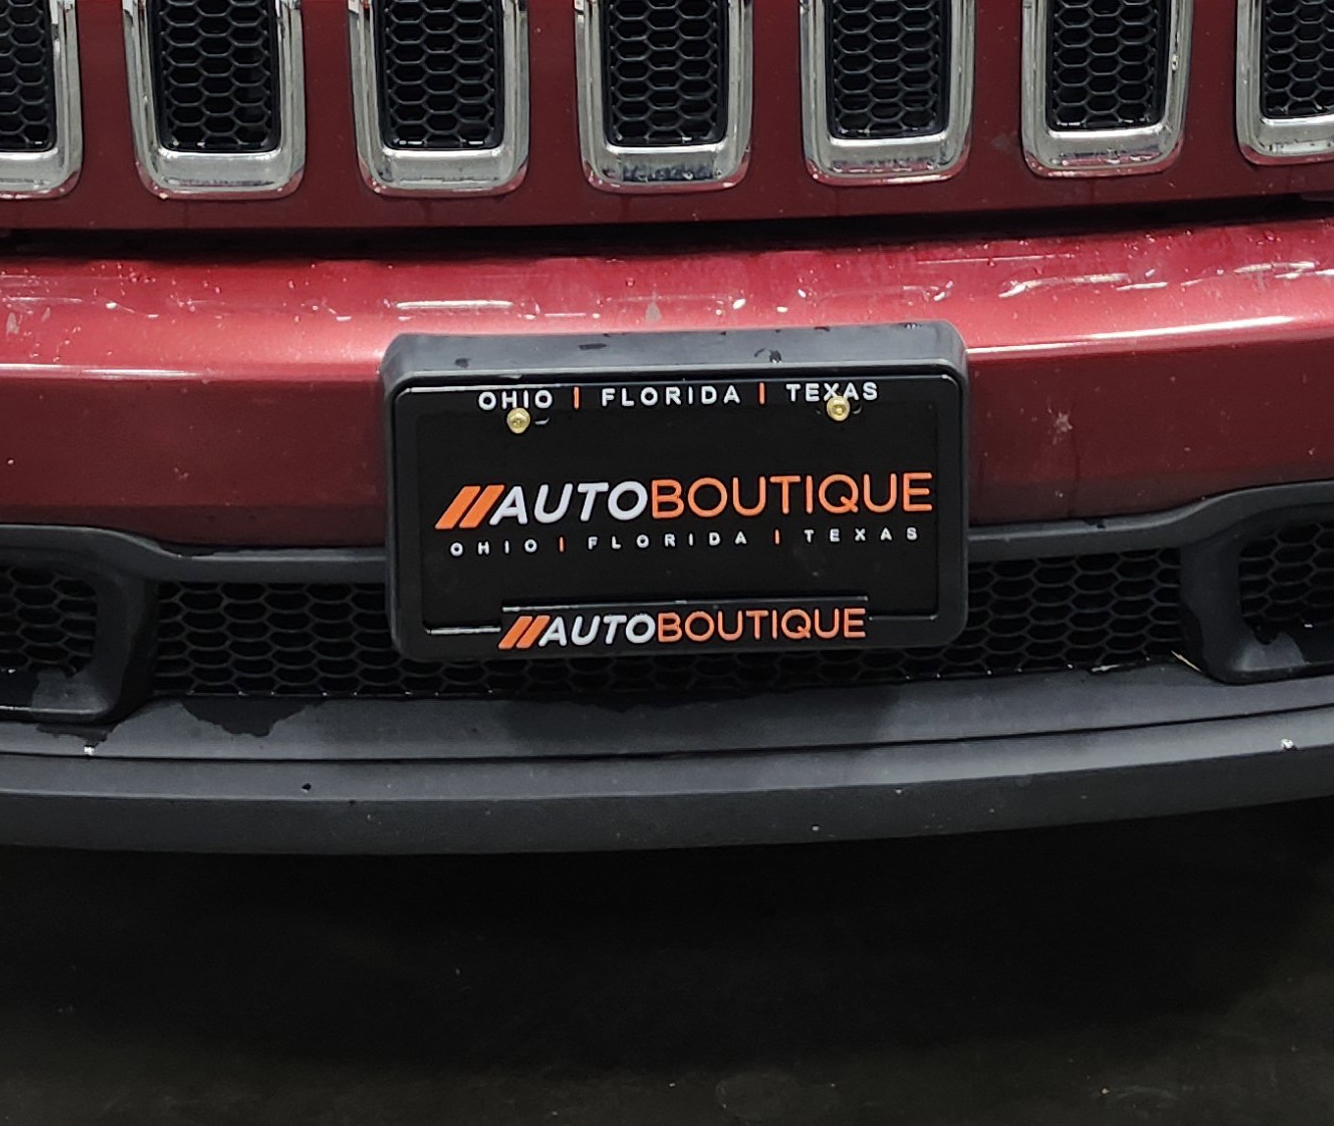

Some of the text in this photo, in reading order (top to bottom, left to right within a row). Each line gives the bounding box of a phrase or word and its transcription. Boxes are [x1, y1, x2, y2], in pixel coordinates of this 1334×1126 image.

[478, 381, 878, 411] OHIO FLORIDA TEXAS
[488, 472, 934, 527] AUTOBOUTIQUE
[450, 526, 919, 557] OHIO FLORIDA TEXAS
[539, 607, 867, 648] AUTOBOUTIQUE
